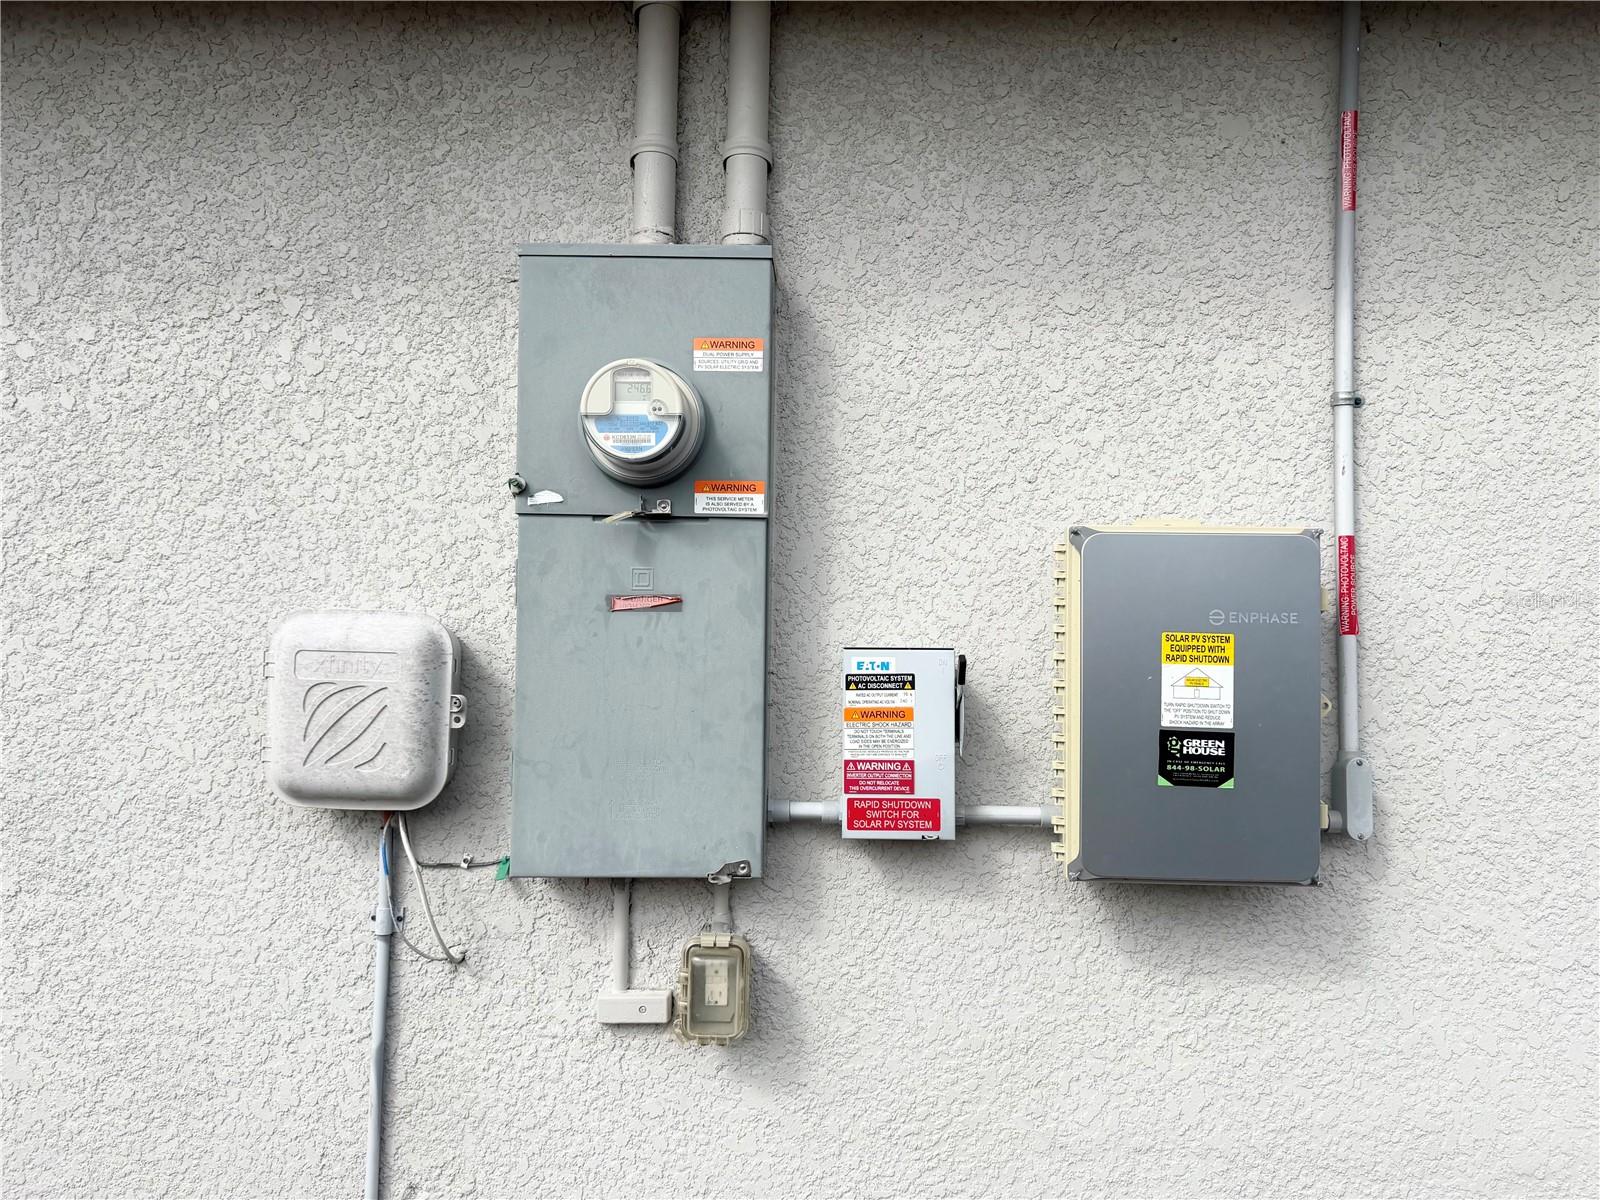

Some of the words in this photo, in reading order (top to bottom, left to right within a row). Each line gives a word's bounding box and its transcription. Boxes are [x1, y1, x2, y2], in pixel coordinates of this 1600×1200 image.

[1343, 112, 1352, 168] PHOTOVOLTAIC
[1343, 170, 1352, 208] WARNING:
[710, 340, 756, 349] WARNING
[710, 484, 756, 492] WARNING
[1340, 537, 1349, 593] PHOTOVOLTAIC
[1341, 594, 1350, 632] WARNING:
[1229, 612, 1298, 624] ENPHASE
[1165, 634, 1189, 642] SOLAR
[1202, 635, 1230, 644] SYSTEM
[1170, 644, 1206, 653] EQUIPPED
[1166, 654, 1187, 662] RAPID
[1189, 654, 1230, 663] SHUTDOWN
[1183, 739, 1225, 747] GREEN
[1183, 747, 1226, 756] HOUSE
[857, 762, 901, 770] WARNING
[854, 800, 879, 808] RAPID
[882, 801, 931, 809] SHUTDOWN
[853, 820, 882, 828] SOLAR
[897, 820, 932, 828] SYSTEM
